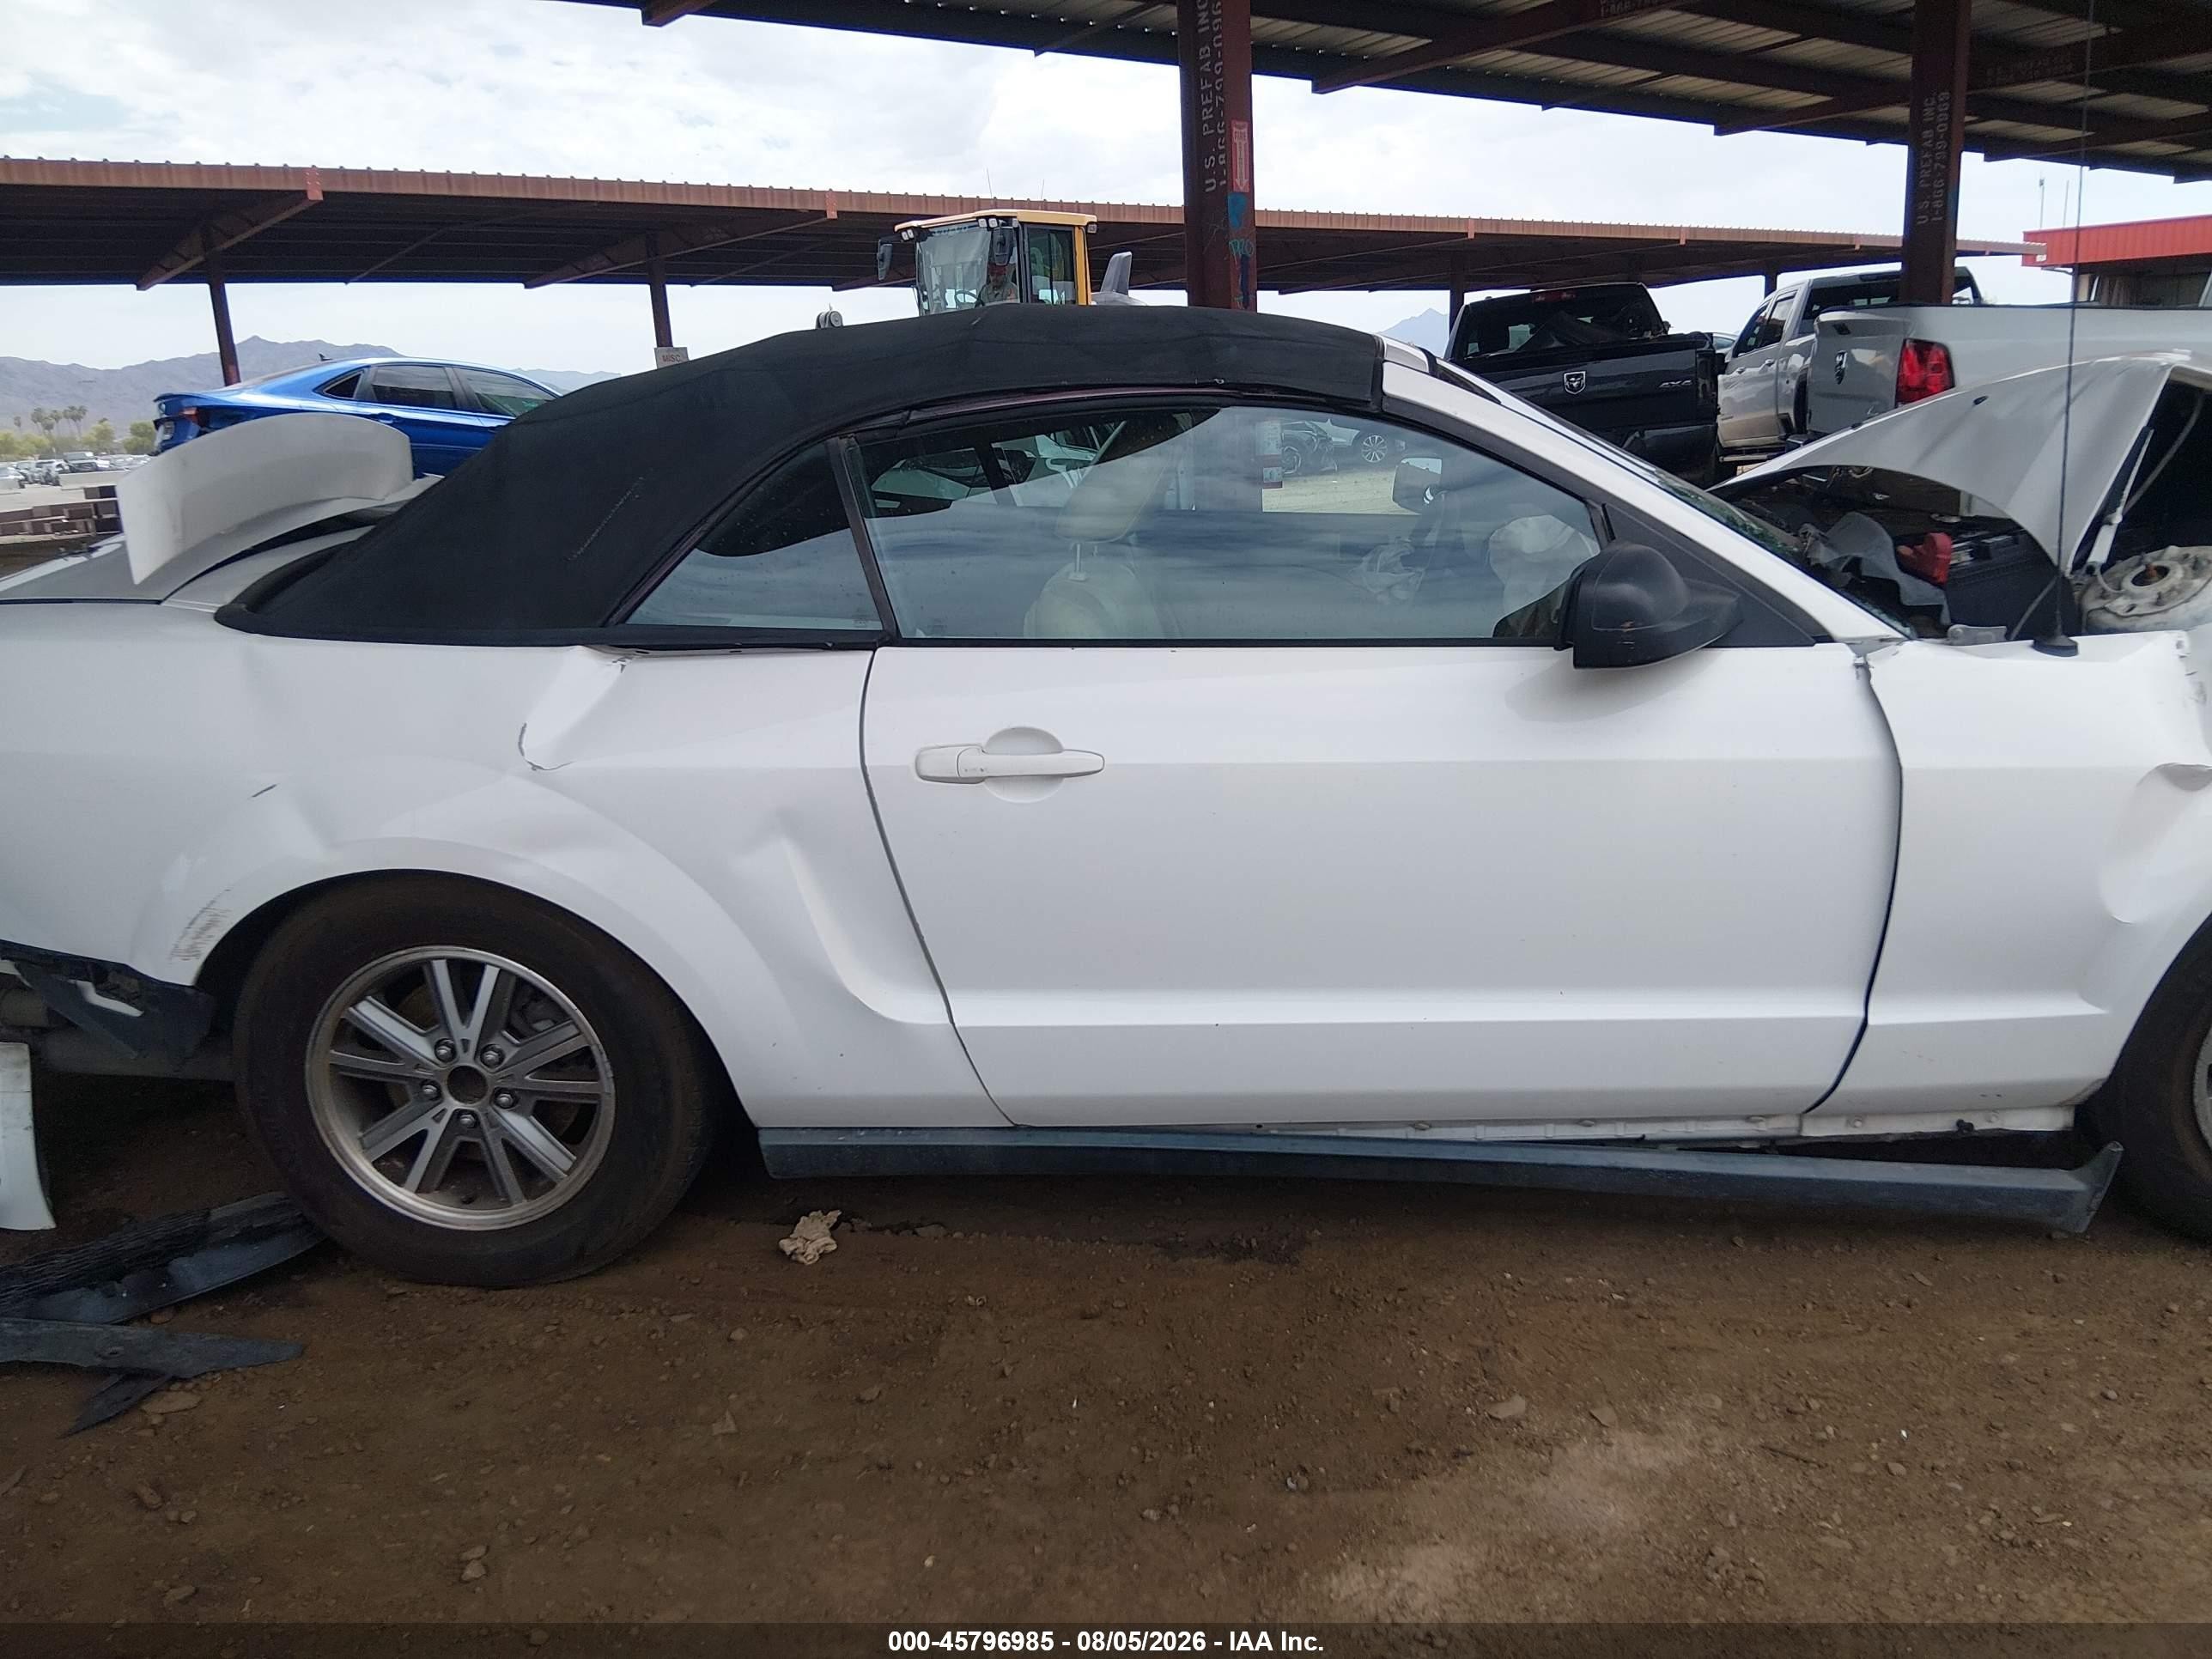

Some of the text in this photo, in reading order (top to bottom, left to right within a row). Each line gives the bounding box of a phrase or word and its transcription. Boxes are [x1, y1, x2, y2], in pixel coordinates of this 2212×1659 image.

[1200, 45, 1214, 136] PREFAB
[1203, 148, 1217, 192] U.S.
[1920, 129, 1934, 188] PREFAB
